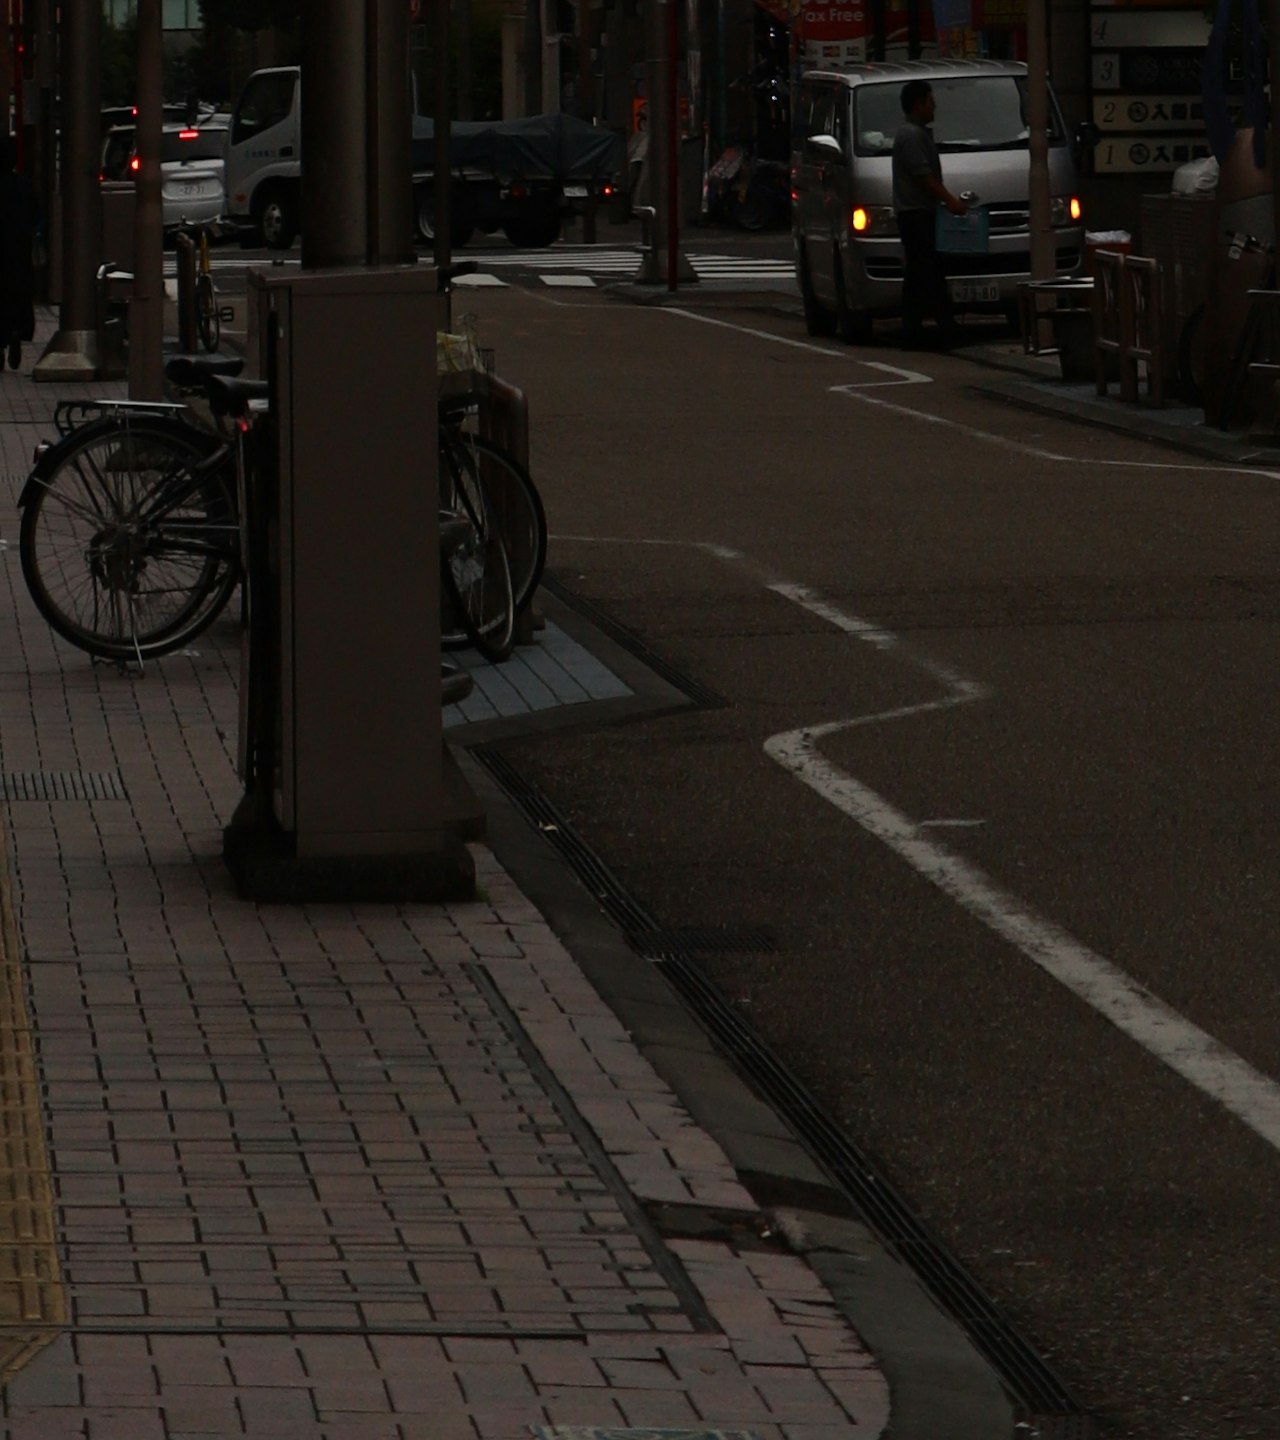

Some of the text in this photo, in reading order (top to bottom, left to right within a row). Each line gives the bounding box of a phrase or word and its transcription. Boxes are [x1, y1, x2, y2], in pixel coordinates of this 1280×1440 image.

[829, 6, 864, 24] Free
[1094, 18, 1108, 41] 4
[1100, 59, 1114, 81] 3
[1103, 101, 1116, 123] 2
[1105, 144, 1114, 164] 1
